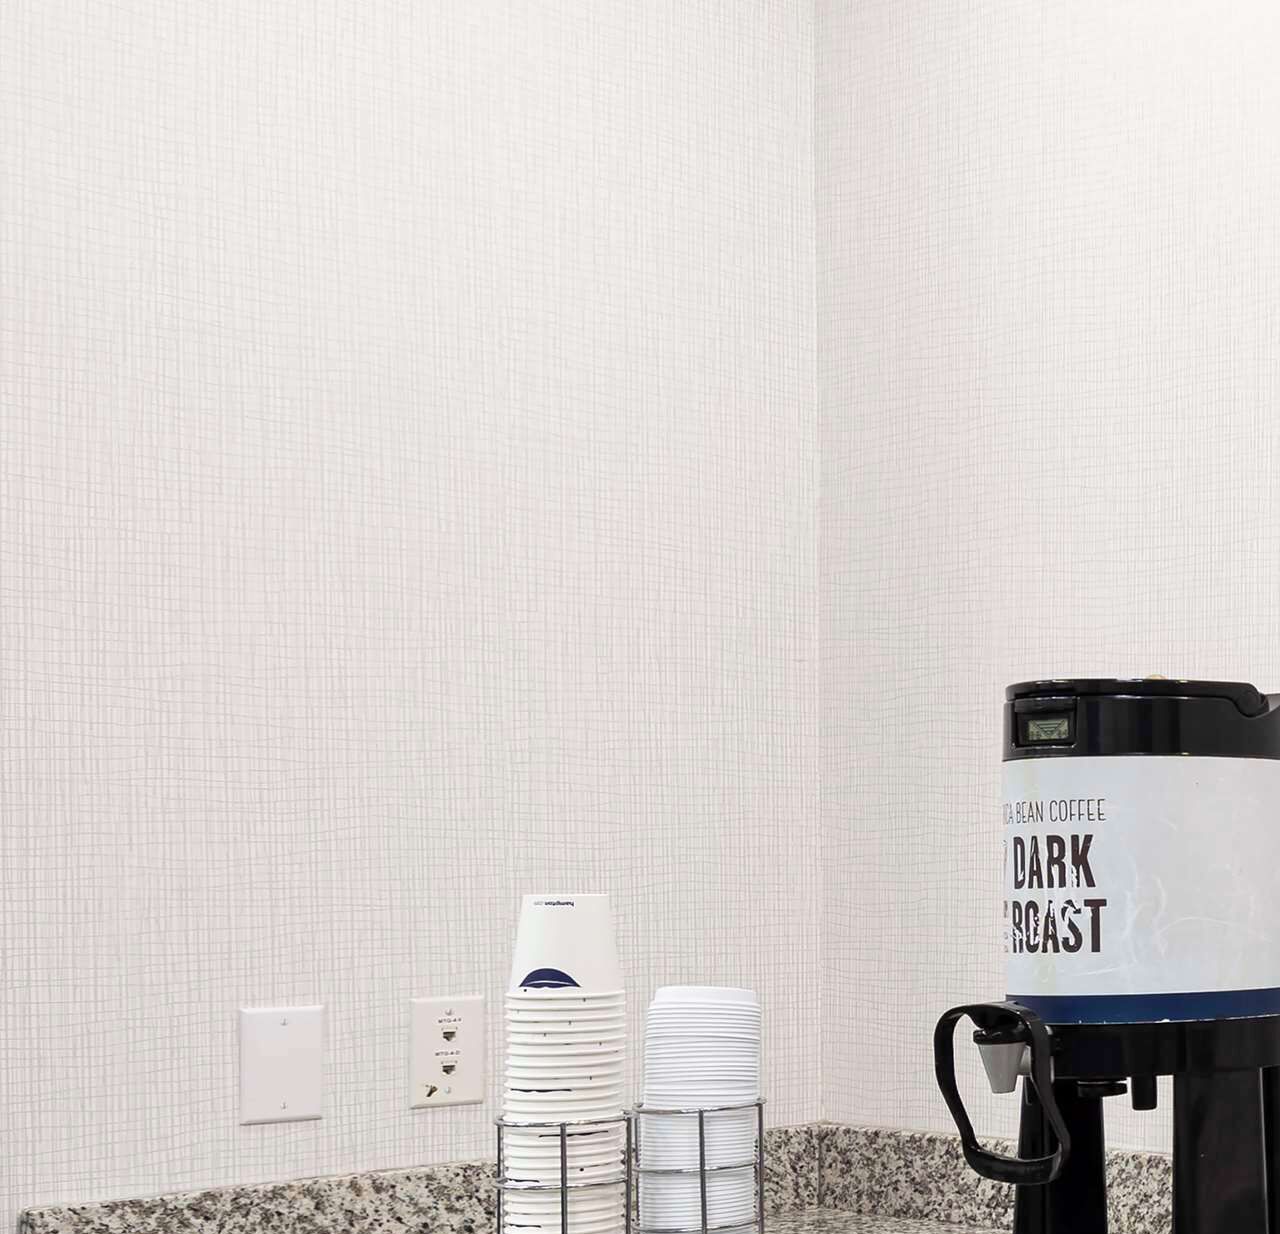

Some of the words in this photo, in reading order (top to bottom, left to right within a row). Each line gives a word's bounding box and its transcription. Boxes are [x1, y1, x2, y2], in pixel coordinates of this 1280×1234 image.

[1016, 801, 1044, 824] BEAN
[1049, 798, 1107, 822] COFFEE
[1013, 834, 1096, 889] DARK
[1012, 898, 1107, 954] ROAST
